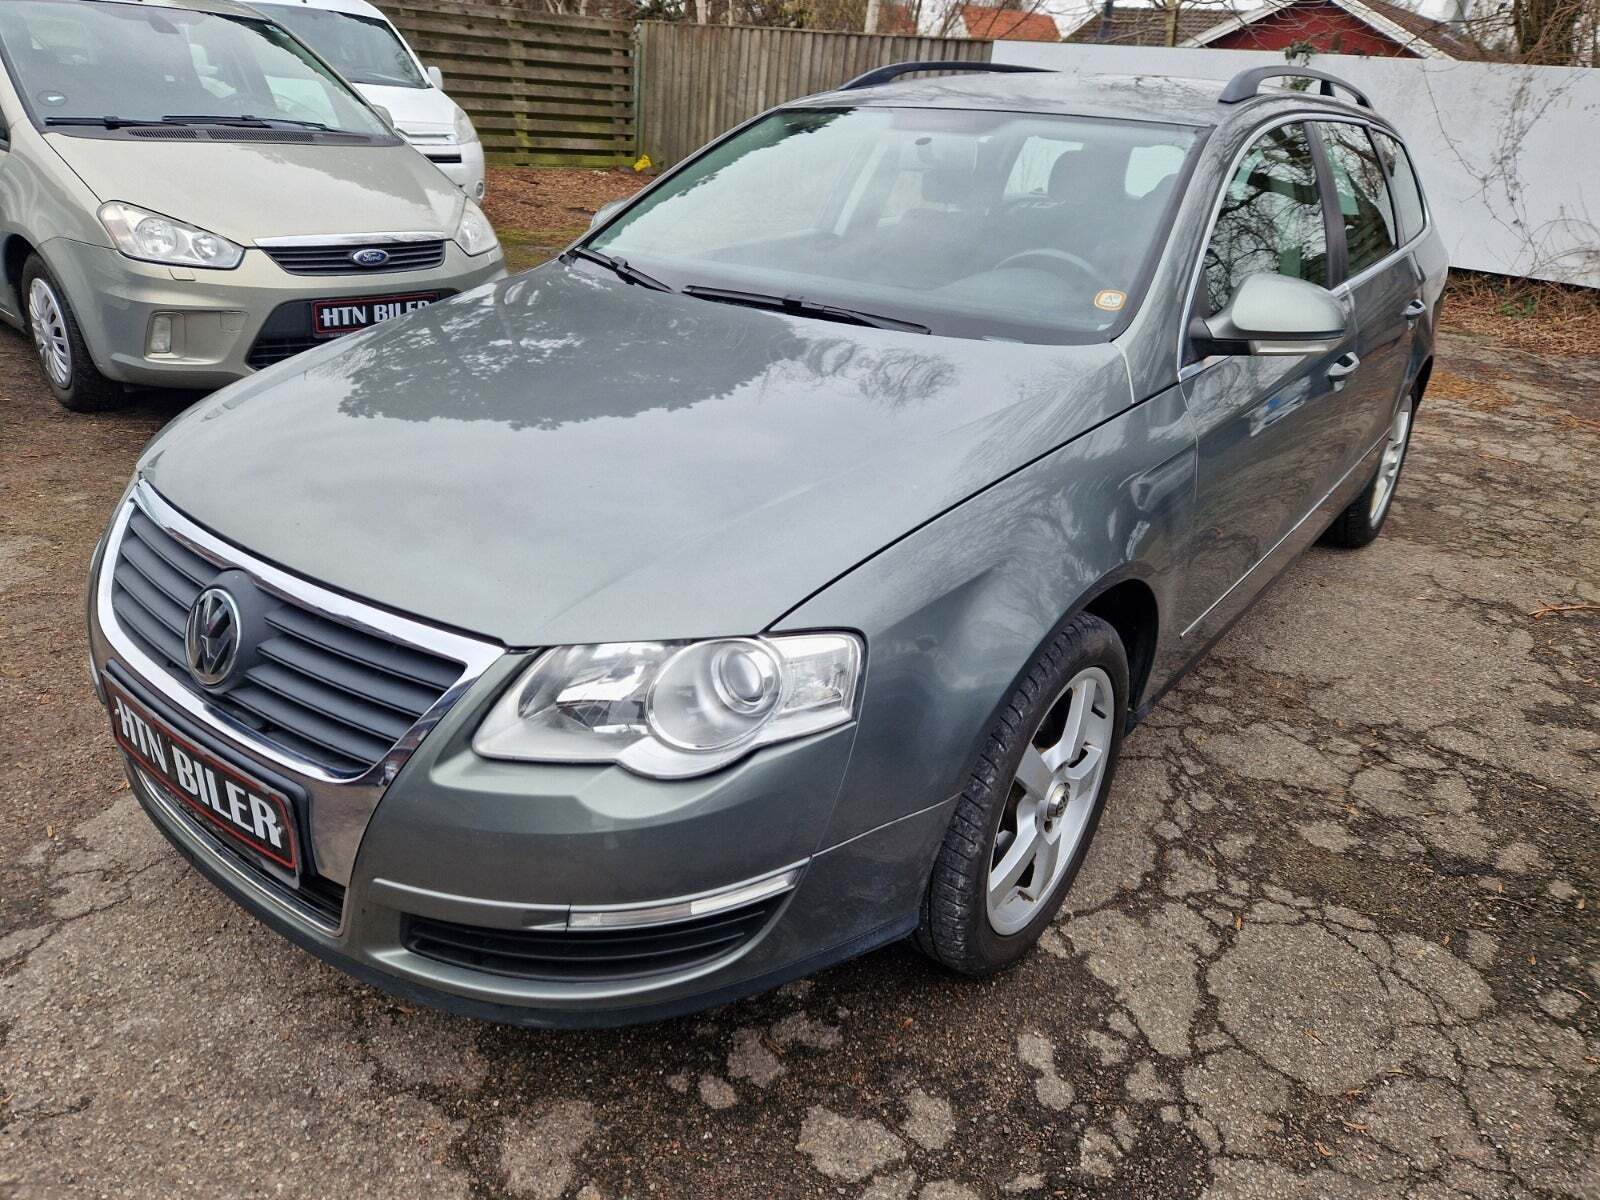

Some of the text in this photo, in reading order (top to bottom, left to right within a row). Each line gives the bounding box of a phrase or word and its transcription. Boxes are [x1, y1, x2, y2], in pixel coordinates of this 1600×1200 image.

[323, 306, 366, 327] HTN
[115, 696, 281, 849] HTN BILER
